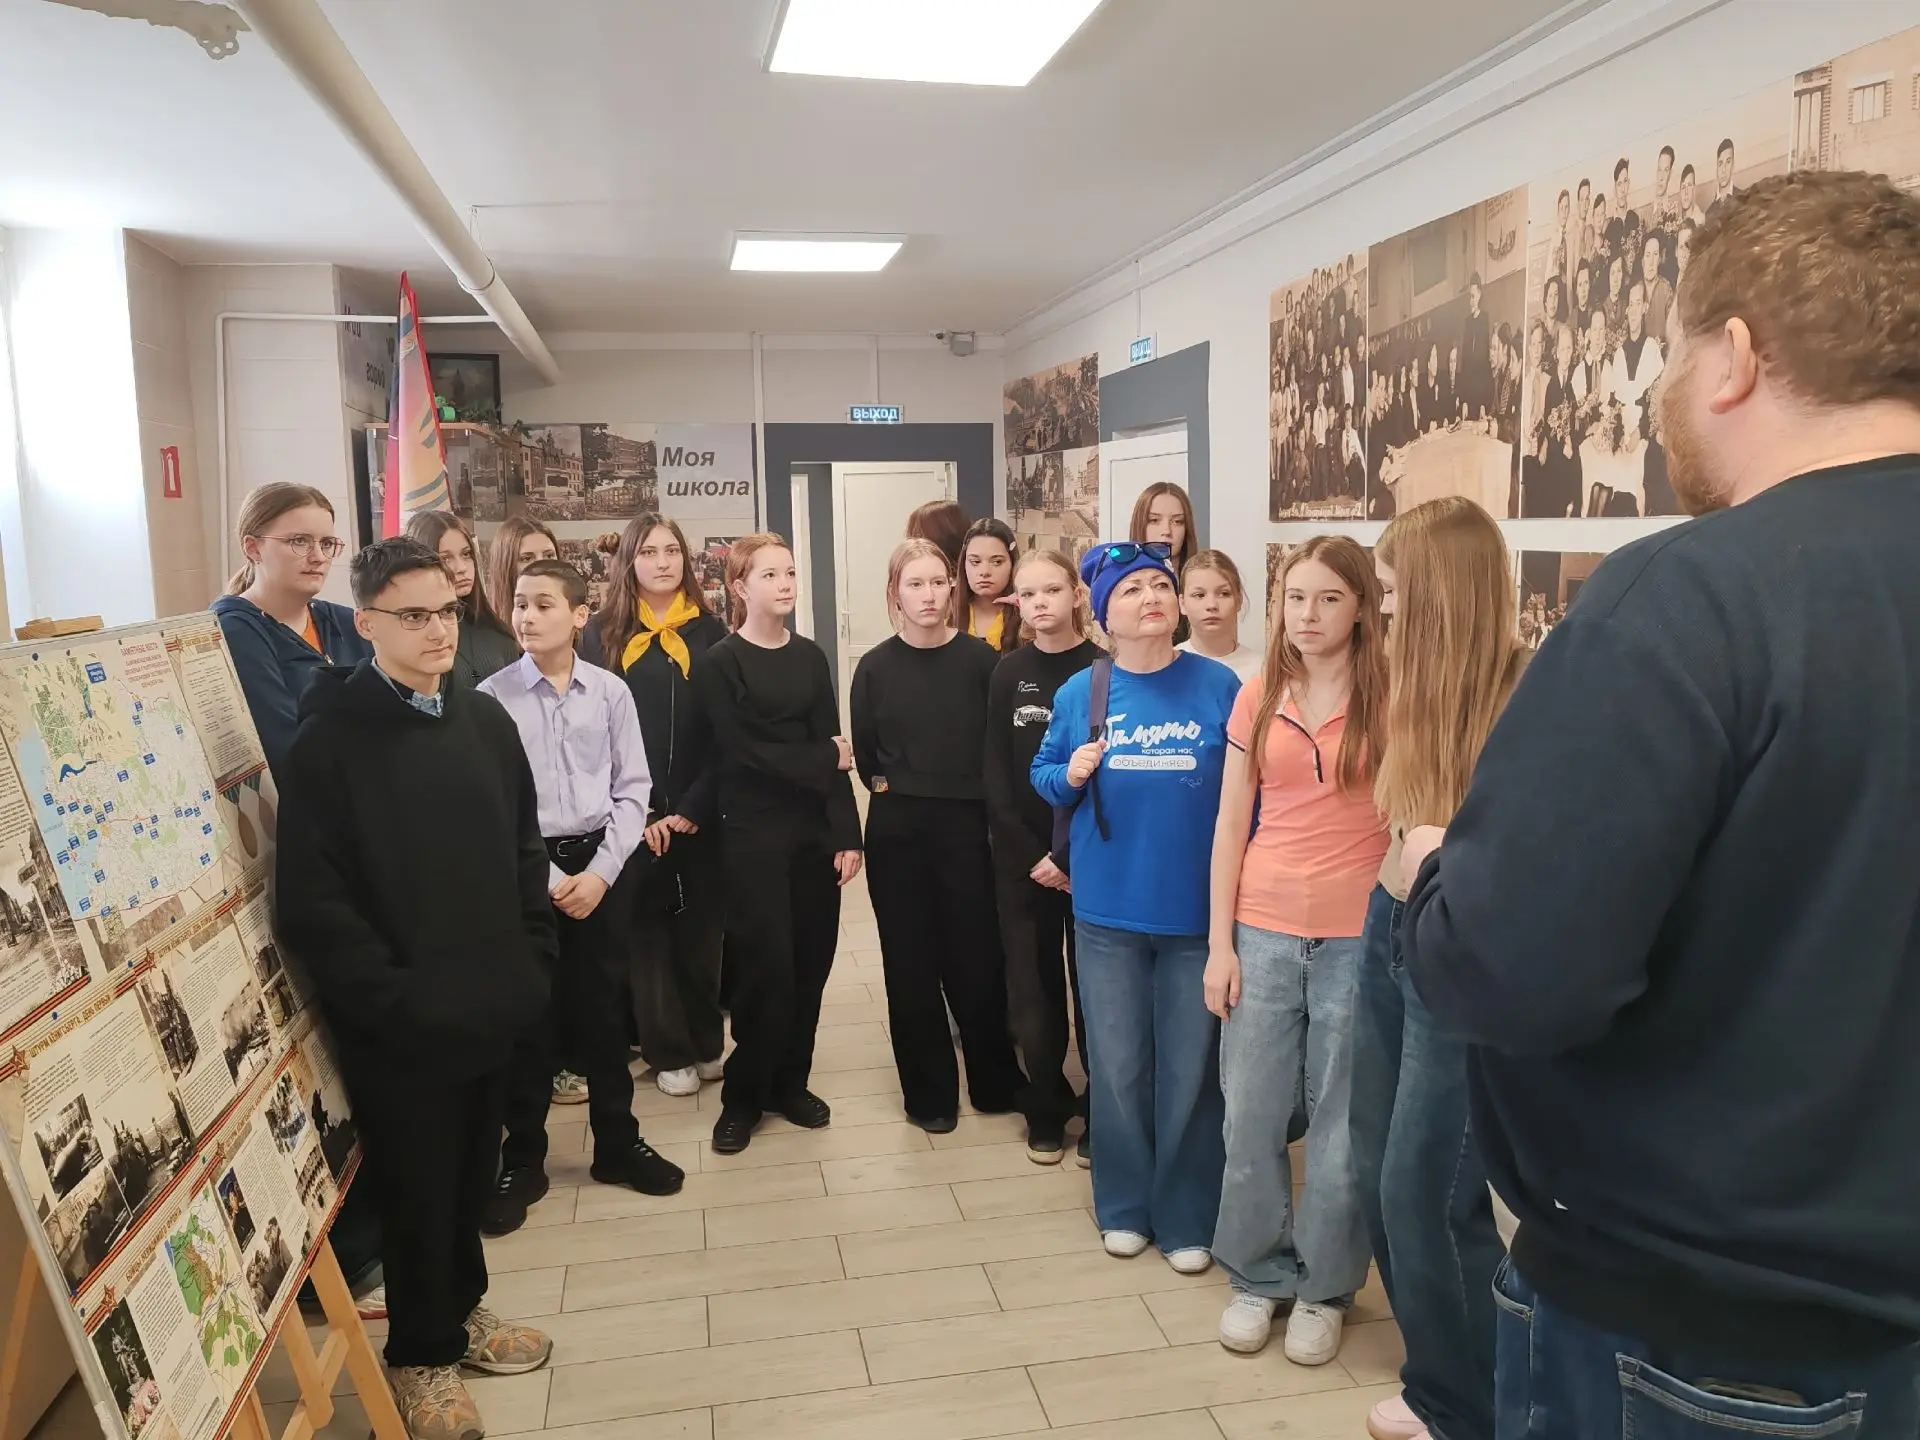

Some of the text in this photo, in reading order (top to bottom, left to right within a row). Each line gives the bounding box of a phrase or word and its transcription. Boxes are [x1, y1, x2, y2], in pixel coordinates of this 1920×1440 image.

[853, 407, 898, 420] ВЫХОД
[662, 446, 715, 467] Моя
[667, 480, 750, 497] школа
[1141, 747, 1194, 756] которая нас
[1113, 757, 1189, 769] объединяет
[29, 1037, 51, 1058] ШТУРМ
